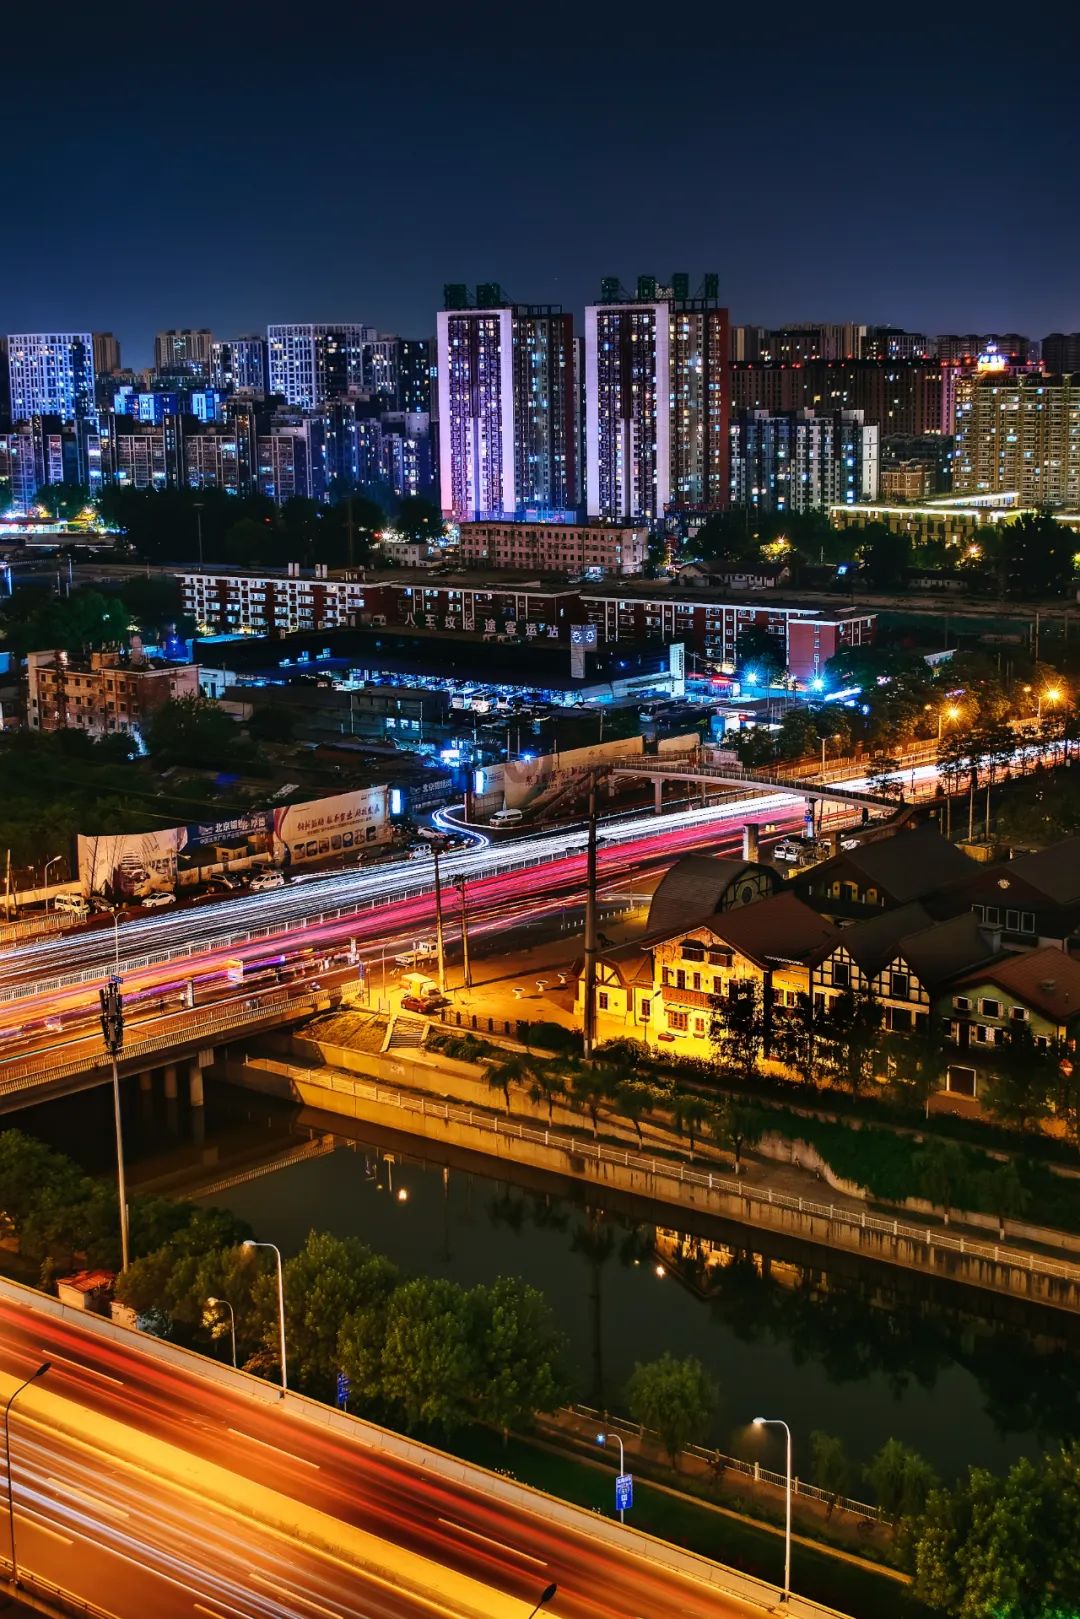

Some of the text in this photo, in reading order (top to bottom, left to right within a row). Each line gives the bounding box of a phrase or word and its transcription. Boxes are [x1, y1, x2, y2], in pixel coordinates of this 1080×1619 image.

[404, 612, 558, 638] 八王坟长途客运站
